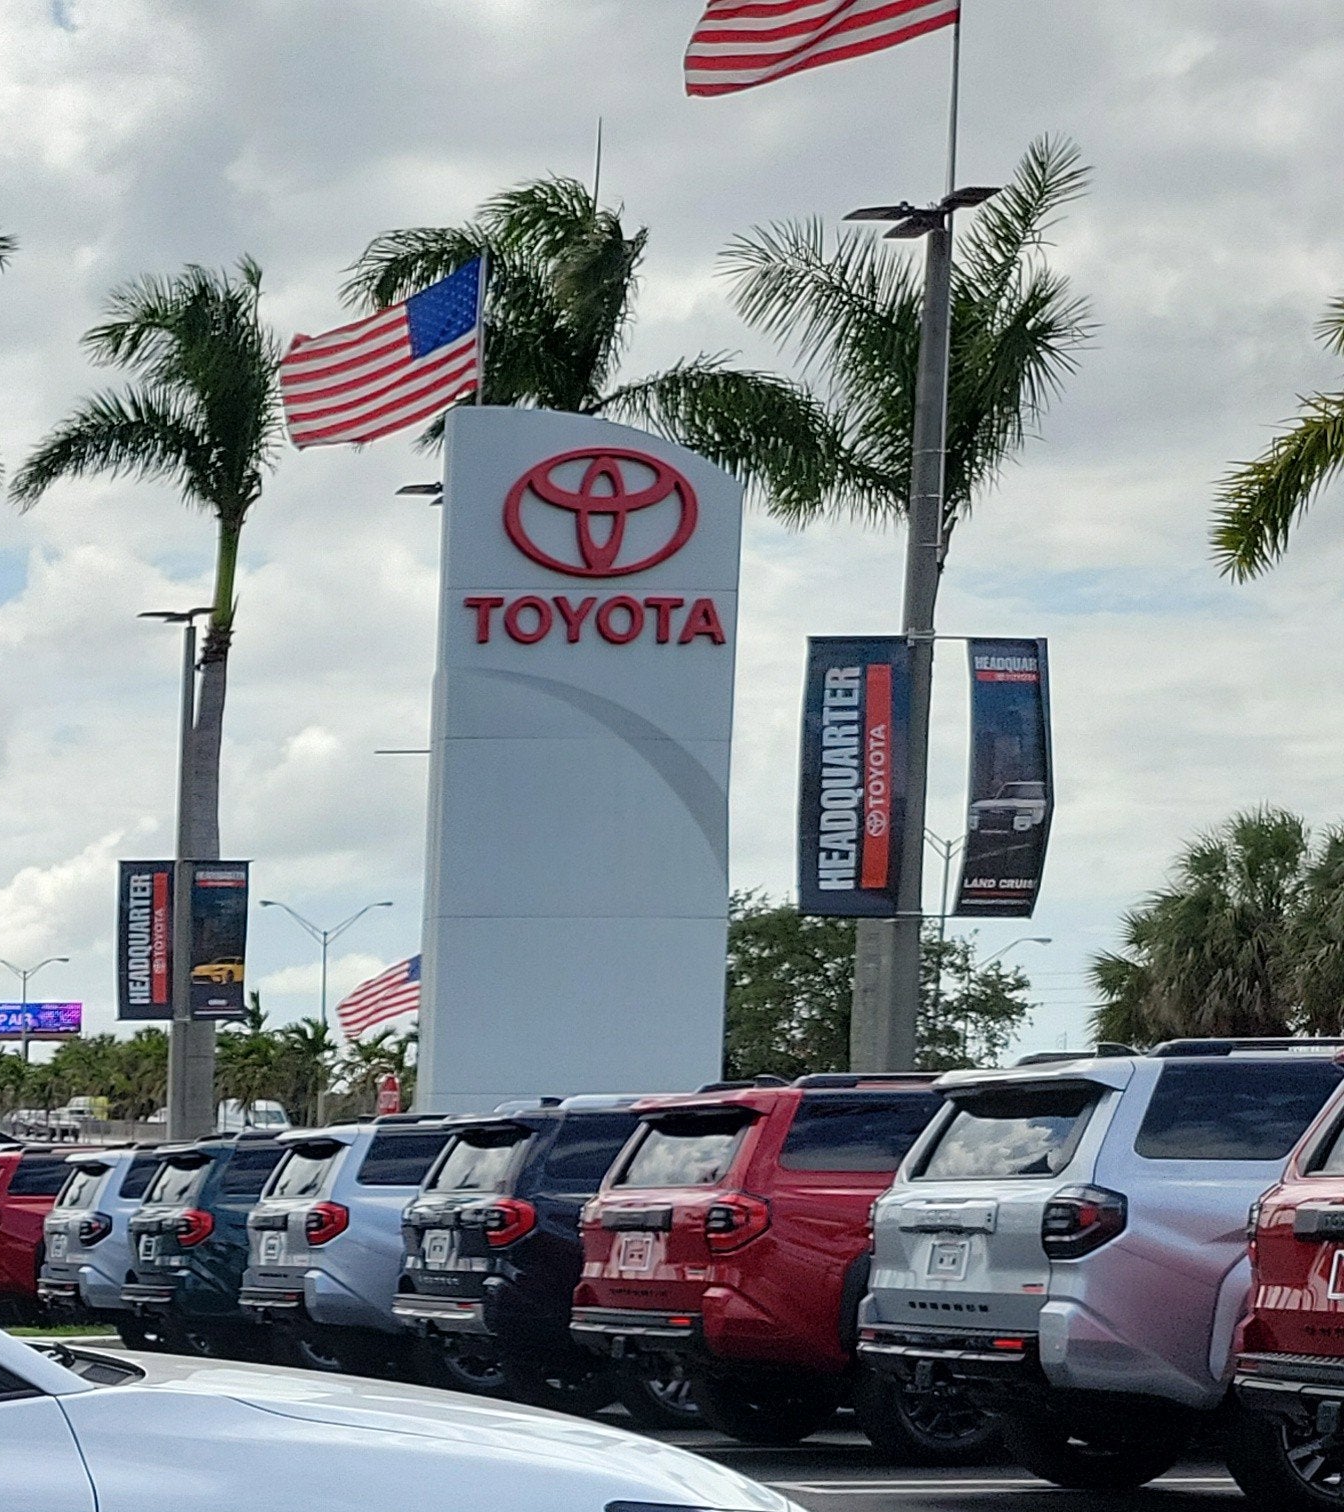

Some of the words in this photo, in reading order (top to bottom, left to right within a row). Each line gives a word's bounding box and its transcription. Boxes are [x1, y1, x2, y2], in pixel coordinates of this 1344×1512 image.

[464, 595, 726, 645] TOYOTA
[818, 667, 863, 890] HEADQUARTER
[869, 725, 886, 808] TOYOTA
[963, 878, 996, 889] LAND
[128, 873, 152, 1005] HEADQUARTER
[153, 907, 167, 957] TOYOTA
